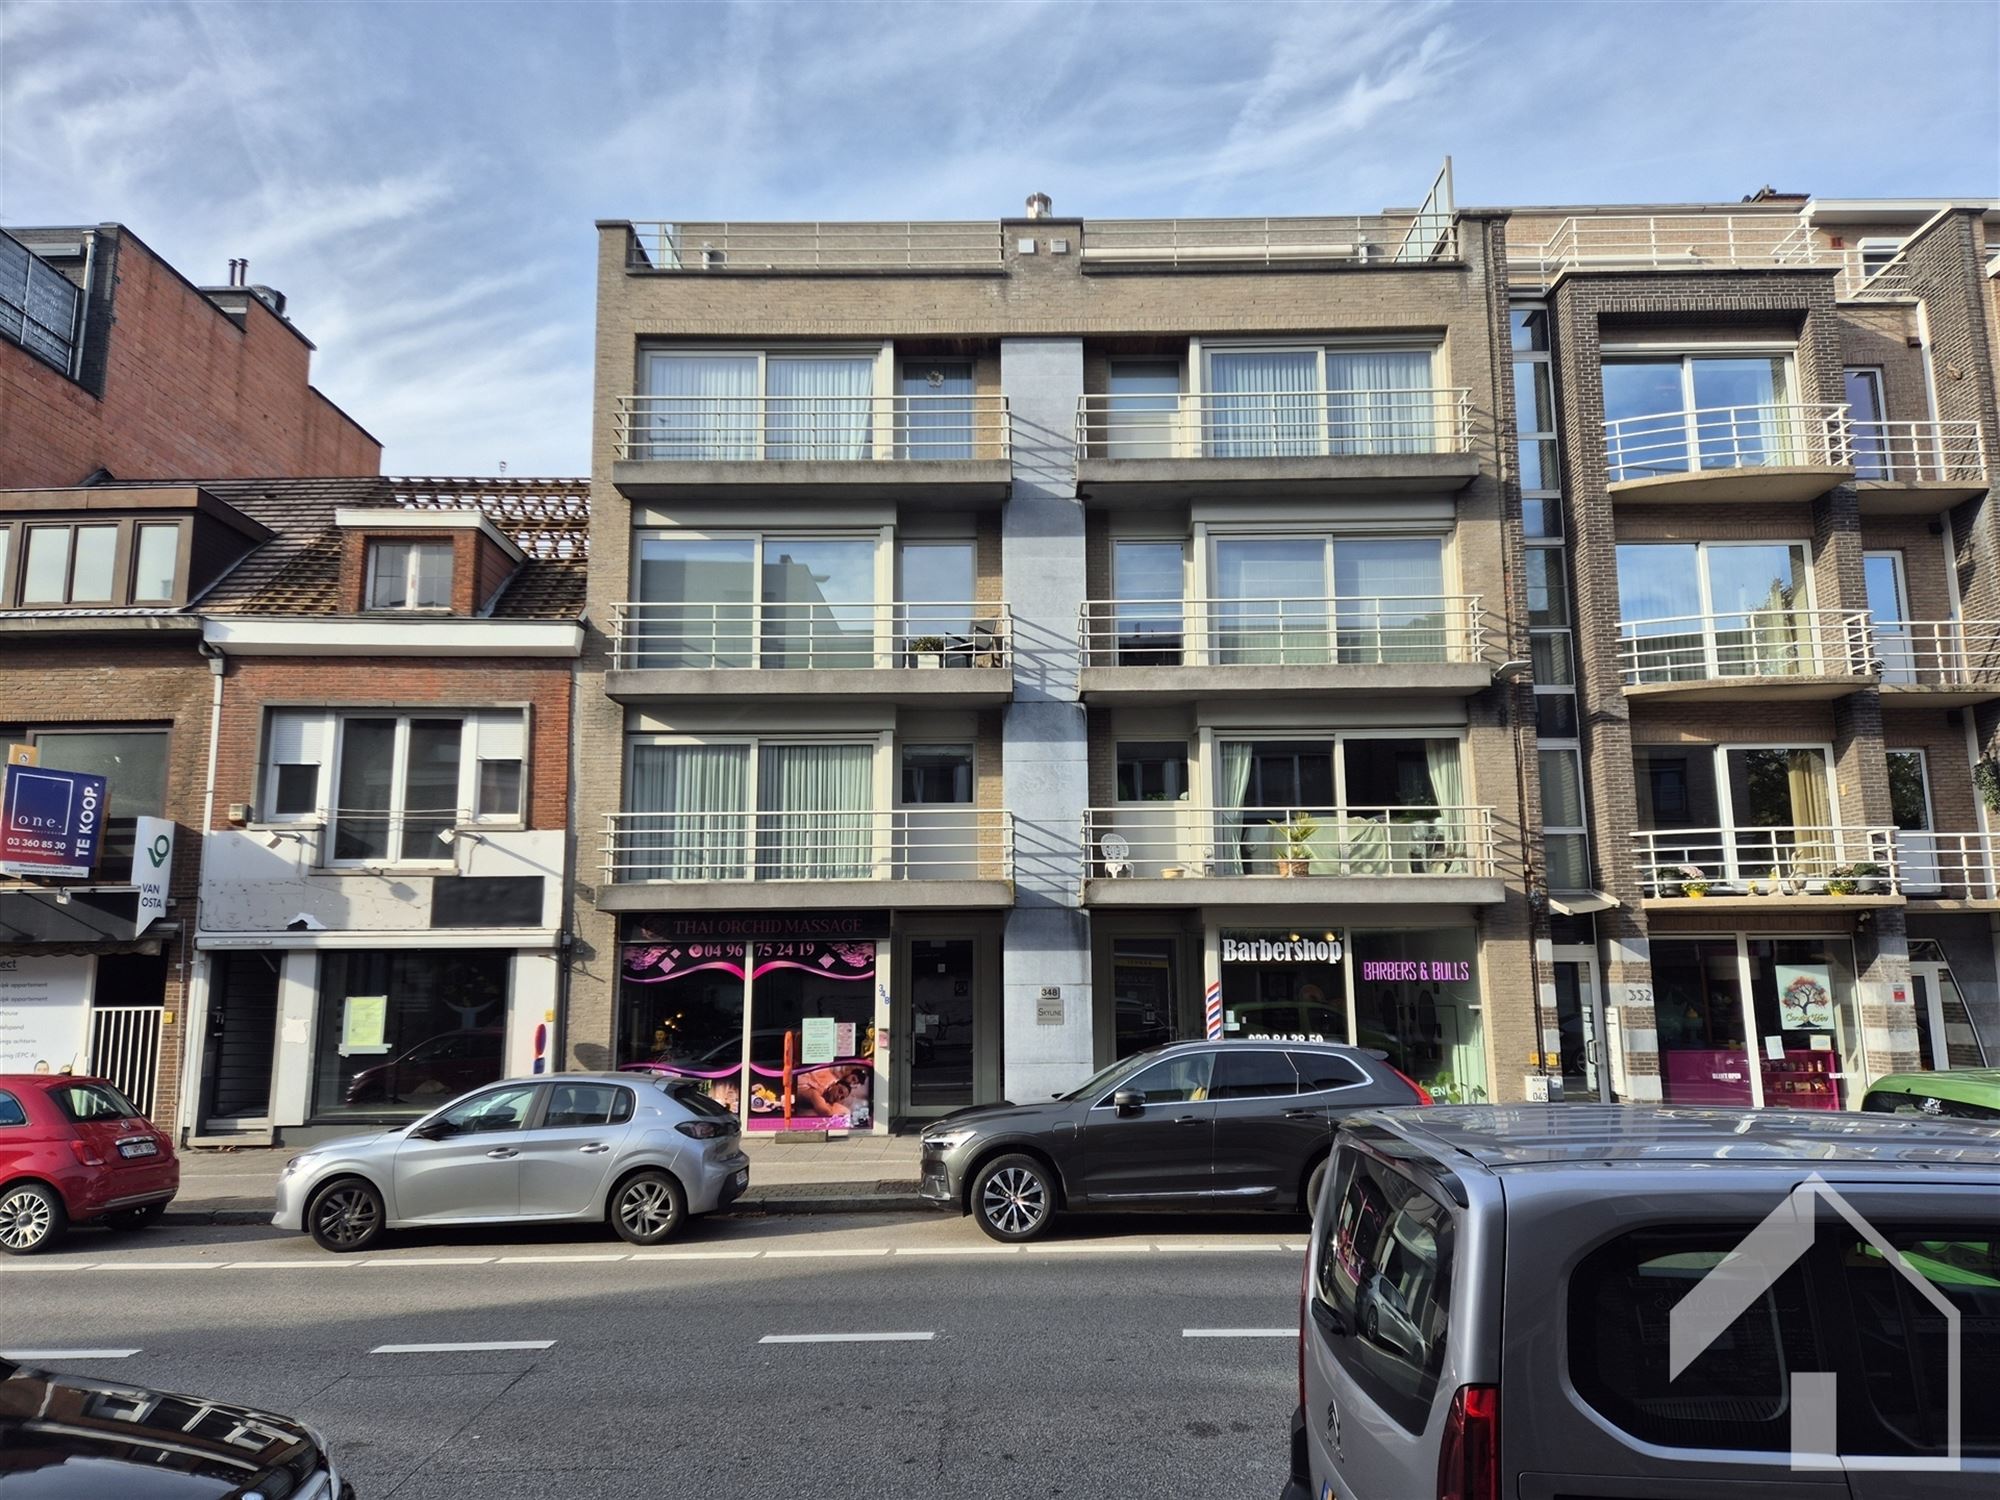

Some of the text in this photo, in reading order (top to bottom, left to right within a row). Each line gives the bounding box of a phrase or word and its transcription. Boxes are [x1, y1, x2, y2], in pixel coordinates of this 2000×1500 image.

[7, 837, 66, 850] 03 360 85 30
[75, 839, 91, 857] TE
[142, 883, 160, 894] VAN
[141, 897, 162, 908] OSTA
[674, 918, 863, 934] THAI ORCHID MASSAGE
[705, 942, 815, 957] 04 96 75 24 19
[1222, 938, 1342, 964] Barbershop
[1363, 961, 1470, 981] BARBERS & BULLS
[1041, 988, 1058, 997] 348
